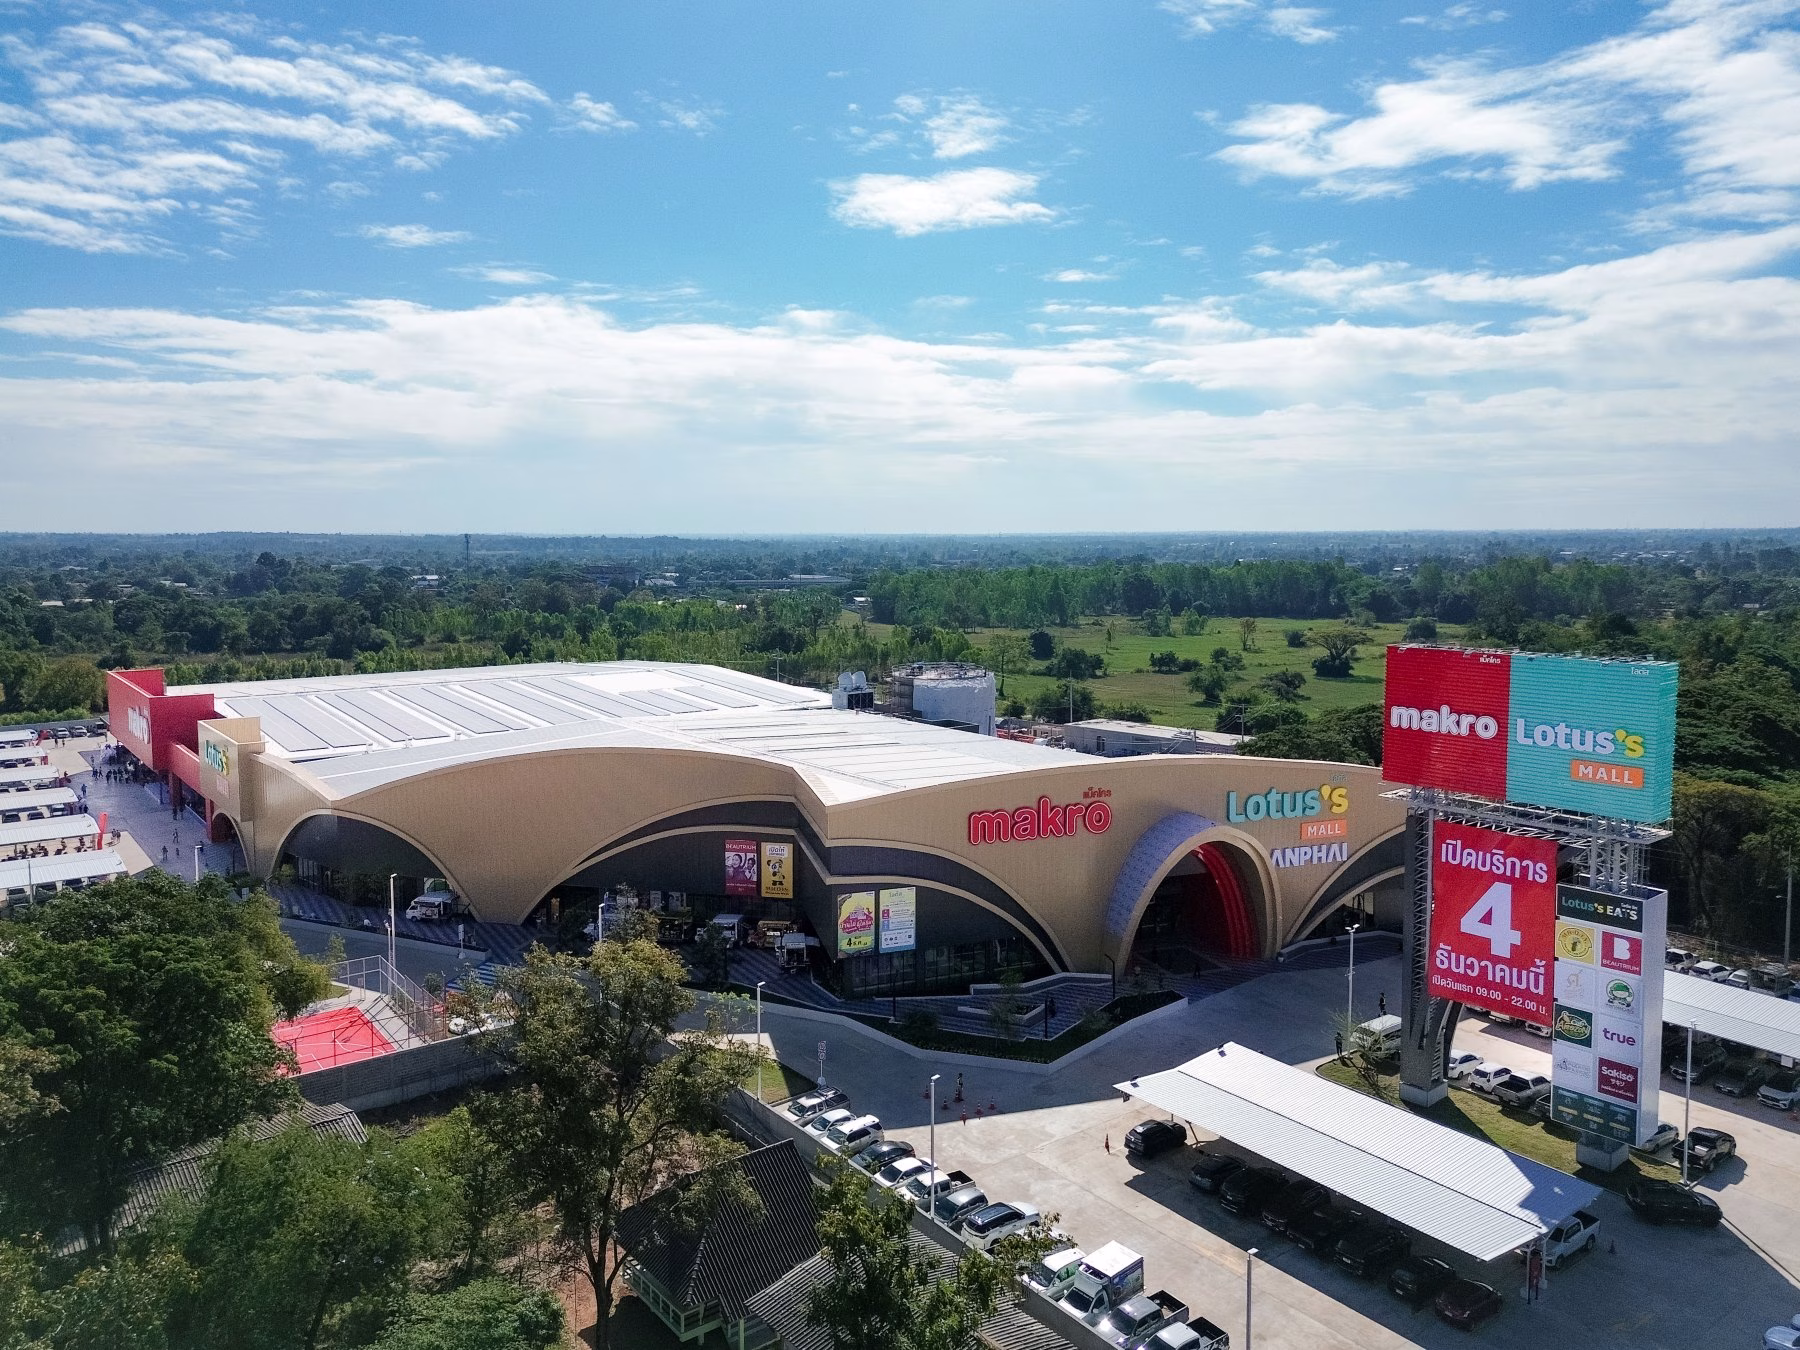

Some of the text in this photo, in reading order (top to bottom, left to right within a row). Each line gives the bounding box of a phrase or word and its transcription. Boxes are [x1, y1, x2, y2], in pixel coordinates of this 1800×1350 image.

[1390, 704, 1498, 740] makro
[1516, 718, 1645, 758] Lotus's
[1578, 764, 1634, 785] MALL
[968, 796, 1113, 846] makro
[1227, 784, 1349, 823] Lotus's
[1307, 823, 1342, 837] MALL
[1270, 842, 1348, 868] ANPHAI
[1441, 839, 1548, 884] เปิดบริการ
[1460, 881, 1521, 958] 4
[1561, 896, 1604, 914] Lotus's
[1435, 943, 1546, 996] ธันวาคมนี้
[1602, 958, 1640, 972] BEAUTRIUM
[1432, 974, 1474, 994] เปิดวันแรก
[1475, 986, 1502, 1001] 09.00
[1511, 995, 1537, 1011] 22.00
[1539, 1005, 1548, 1016] น.
[1602, 1027, 1636, 1046] true
